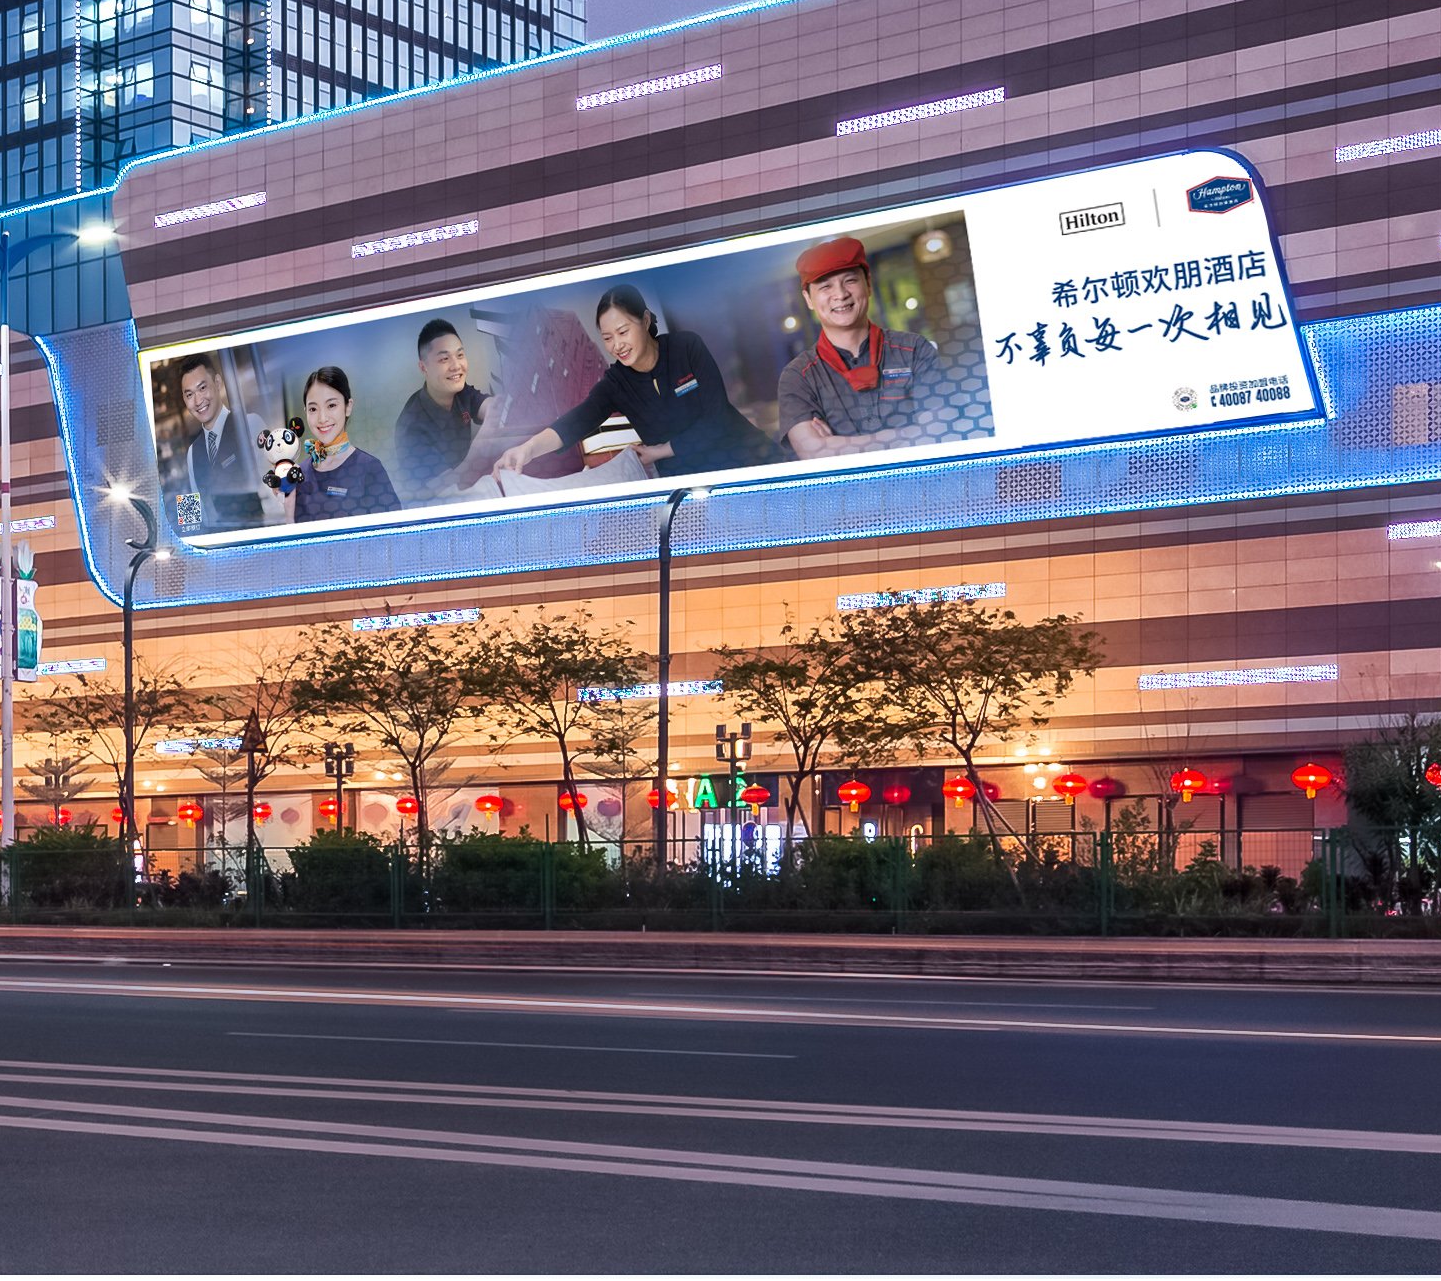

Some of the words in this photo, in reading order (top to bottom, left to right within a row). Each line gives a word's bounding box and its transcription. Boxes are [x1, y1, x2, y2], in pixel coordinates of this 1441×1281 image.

[1192, 183, 1246, 200] Hampton
[1065, 209, 1120, 231] Hilton
[1051, 250, 1267, 309] 希尔顿欢朋酒店
[995, 292, 1288, 367] 不辜负每一次相见
[1255, 385, 1291, 402] 40088
